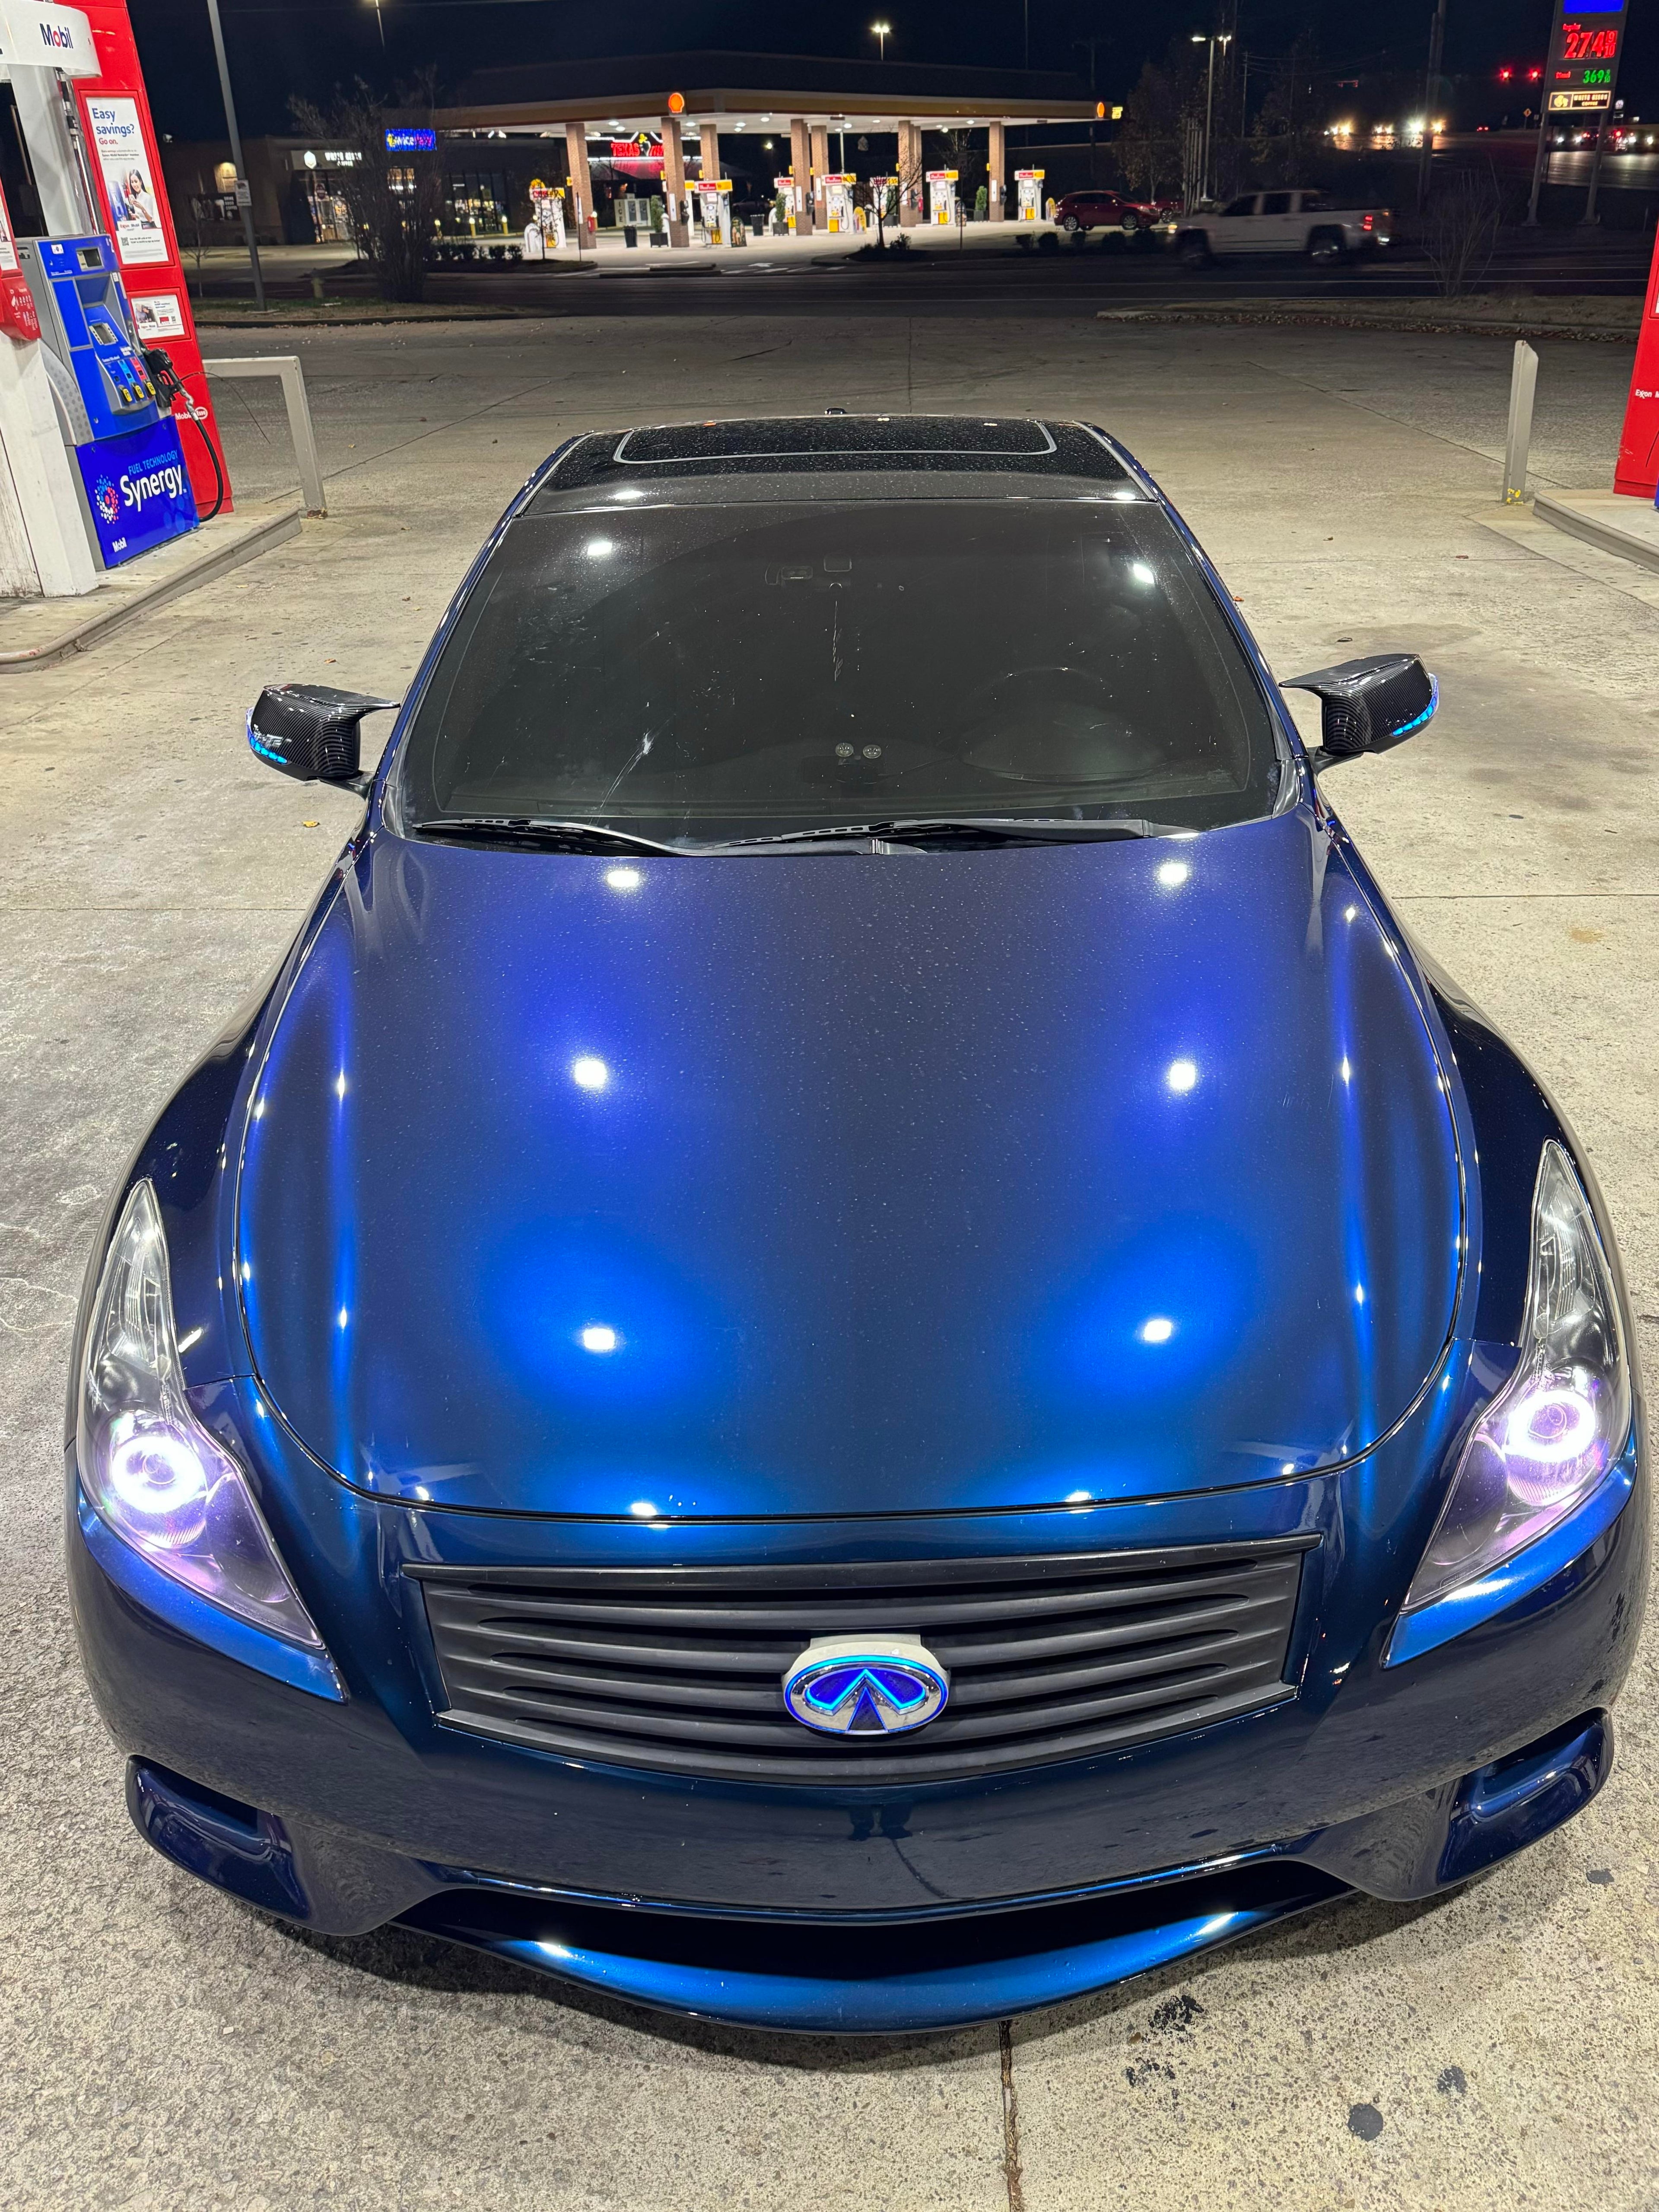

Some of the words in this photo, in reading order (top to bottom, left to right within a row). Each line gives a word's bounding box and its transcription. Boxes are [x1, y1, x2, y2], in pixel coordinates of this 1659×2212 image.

[40, 23, 73, 48] Mobil
[92, 108, 115, 122] Easy
[96, 122, 135, 137] savings?
[610, 143, 639, 156] TEXAS
[1635, 389, 1653, 399] Exxon
[175, 411, 192, 420] Mobi
[128, 463, 143, 476] FUEL
[143, 450, 178, 470] TECHNOLOGY
[120, 464, 183, 512] Synergy
[112, 537, 127, 552] Mobil
